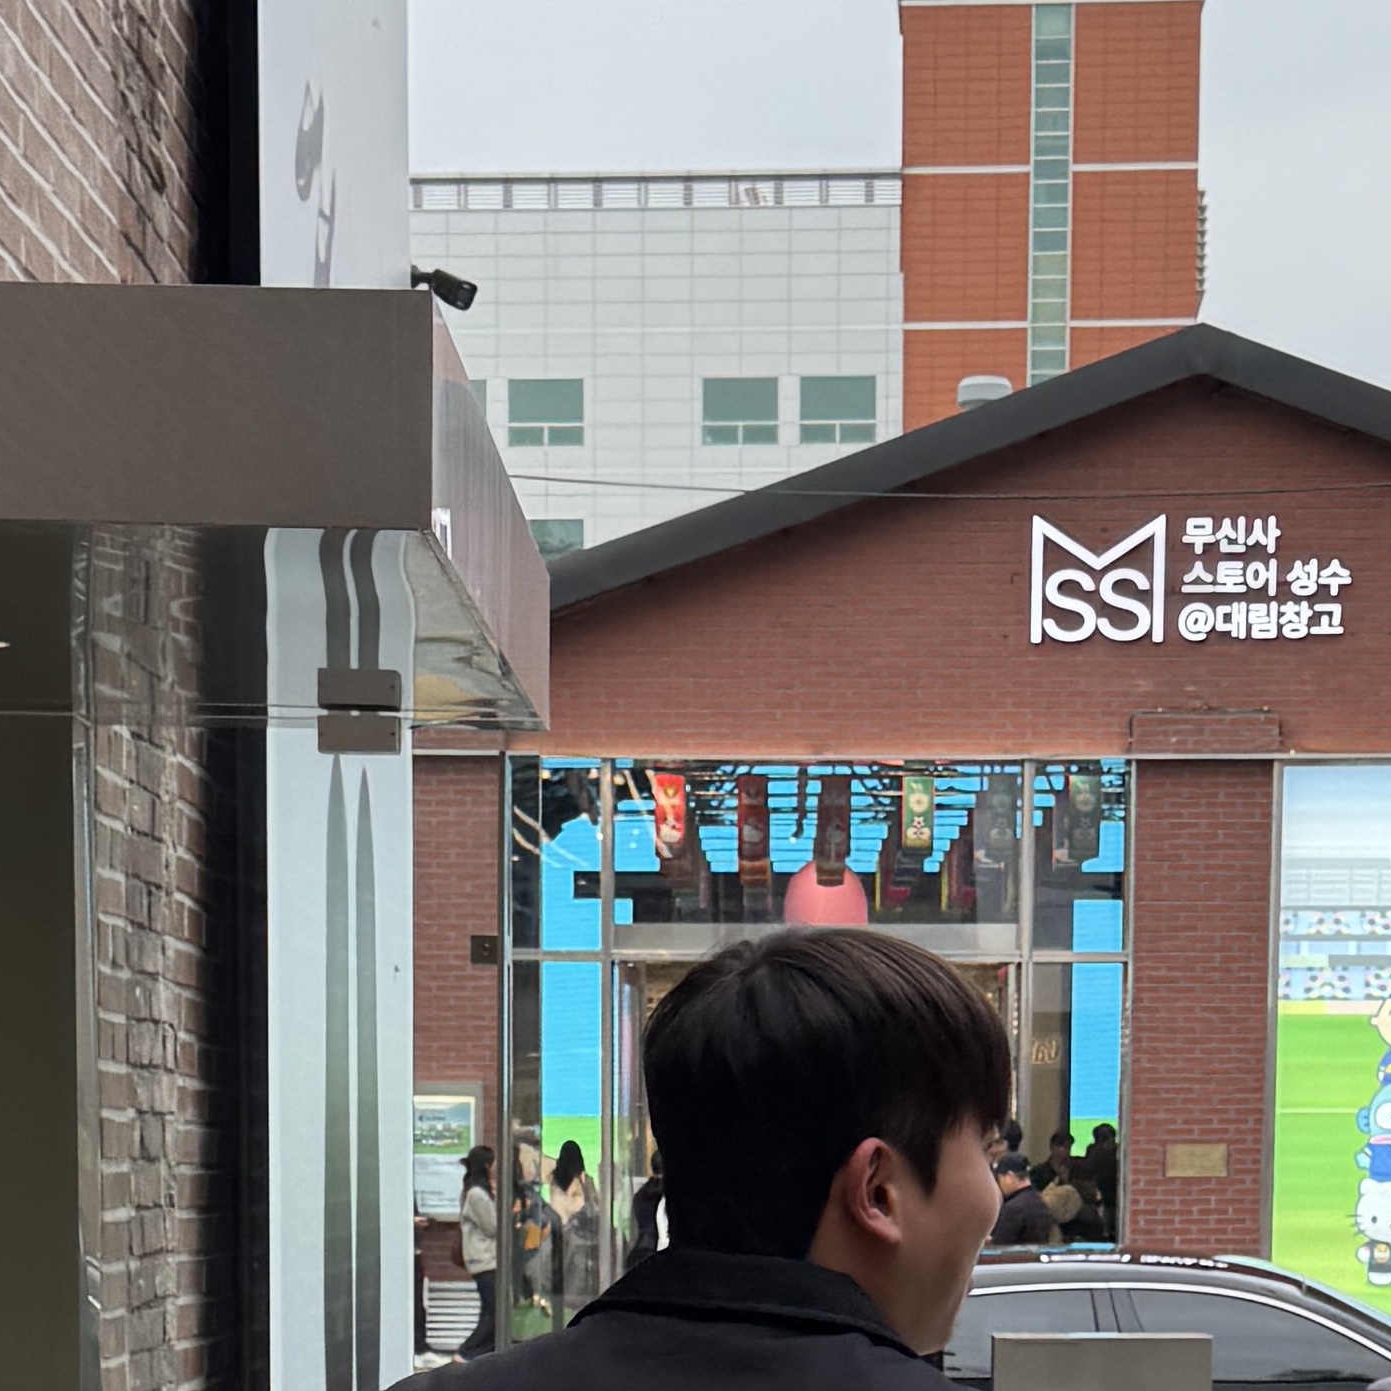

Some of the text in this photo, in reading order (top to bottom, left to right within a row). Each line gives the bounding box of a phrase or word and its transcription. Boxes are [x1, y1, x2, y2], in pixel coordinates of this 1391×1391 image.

[1181, 515, 1282, 555] 무신사
[1180, 557, 1352, 597] 스토어 성수
[1177, 600, 1345, 641] @대림창고
